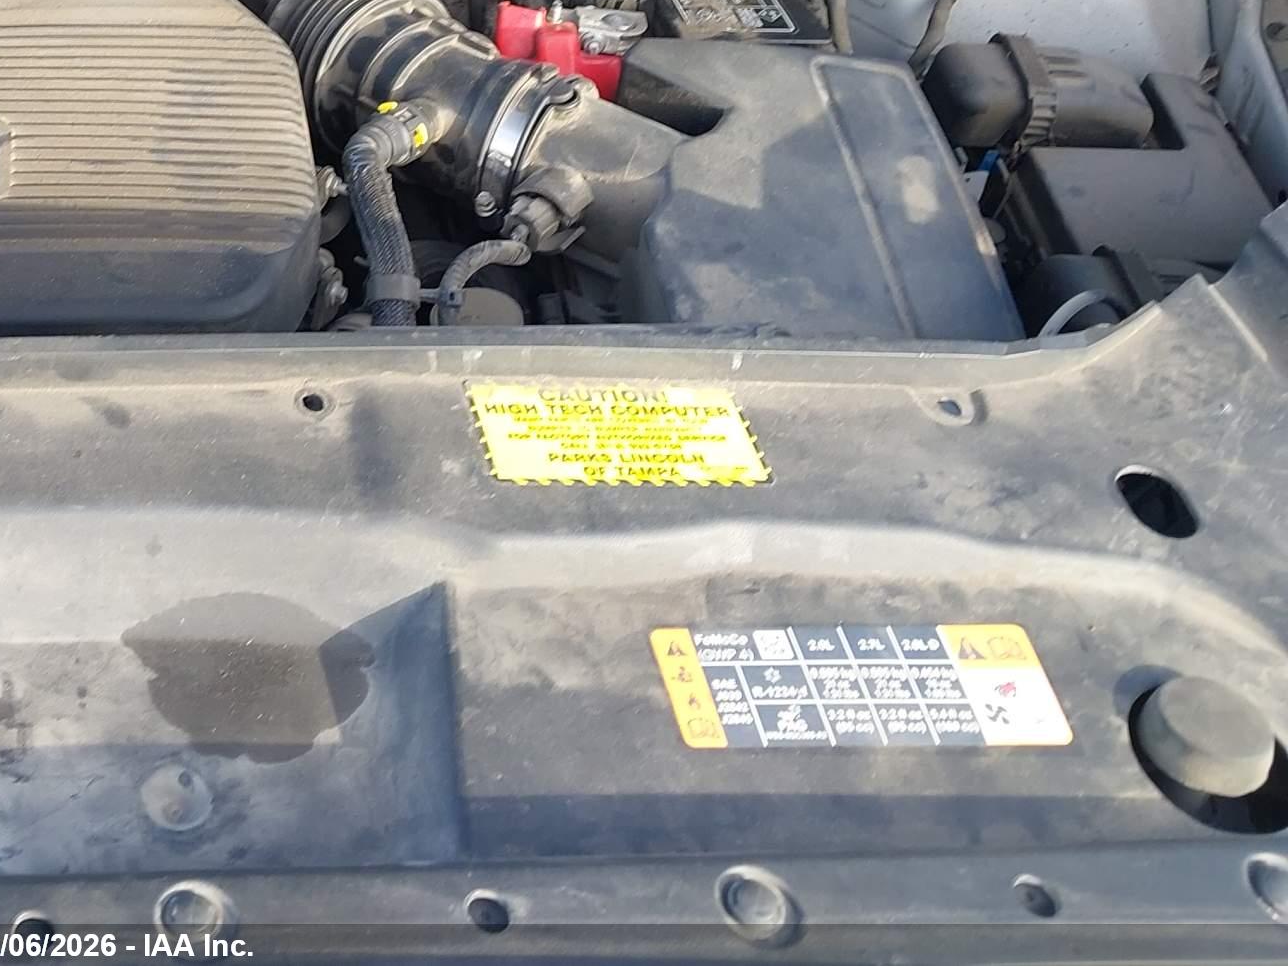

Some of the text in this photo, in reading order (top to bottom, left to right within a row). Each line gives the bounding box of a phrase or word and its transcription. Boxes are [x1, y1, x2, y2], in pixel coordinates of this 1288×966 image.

[538, 389, 669, 403] CAUTION!
[485, 404, 731, 418] HIGH TECH COMPUTER
[548, 452, 705, 464] PARKS LINCOLN
[583, 466, 681, 477] OF TAMPA
